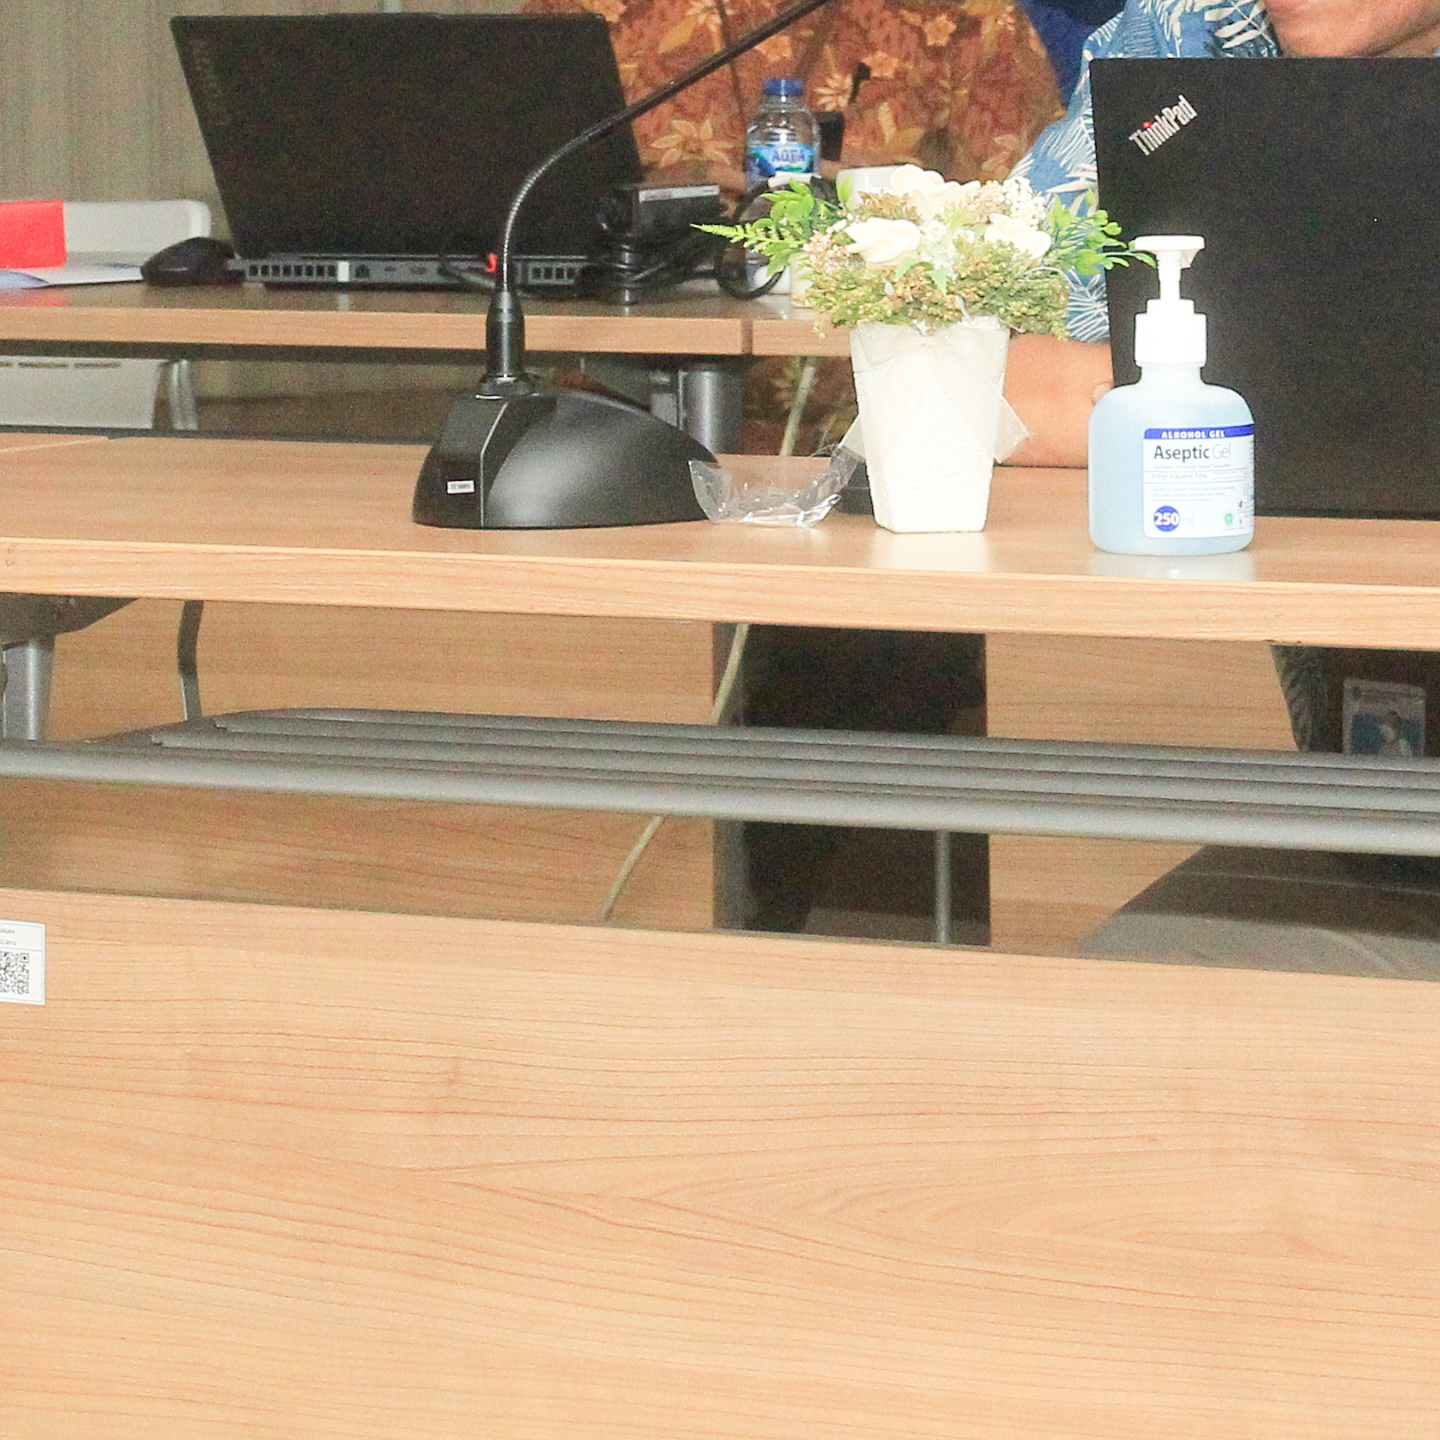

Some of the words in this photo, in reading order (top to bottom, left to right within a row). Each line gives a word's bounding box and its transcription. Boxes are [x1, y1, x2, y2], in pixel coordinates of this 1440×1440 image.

[1128, 94, 1198, 156] ThinkPad
[1161, 431, 1207, 439] ALKOHOL
[1209, 430, 1225, 438] GEL
[1153, 444, 1210, 463] Aseptic
[1211, 442, 1231, 459] Gel
[1154, 512, 1179, 526] 250
